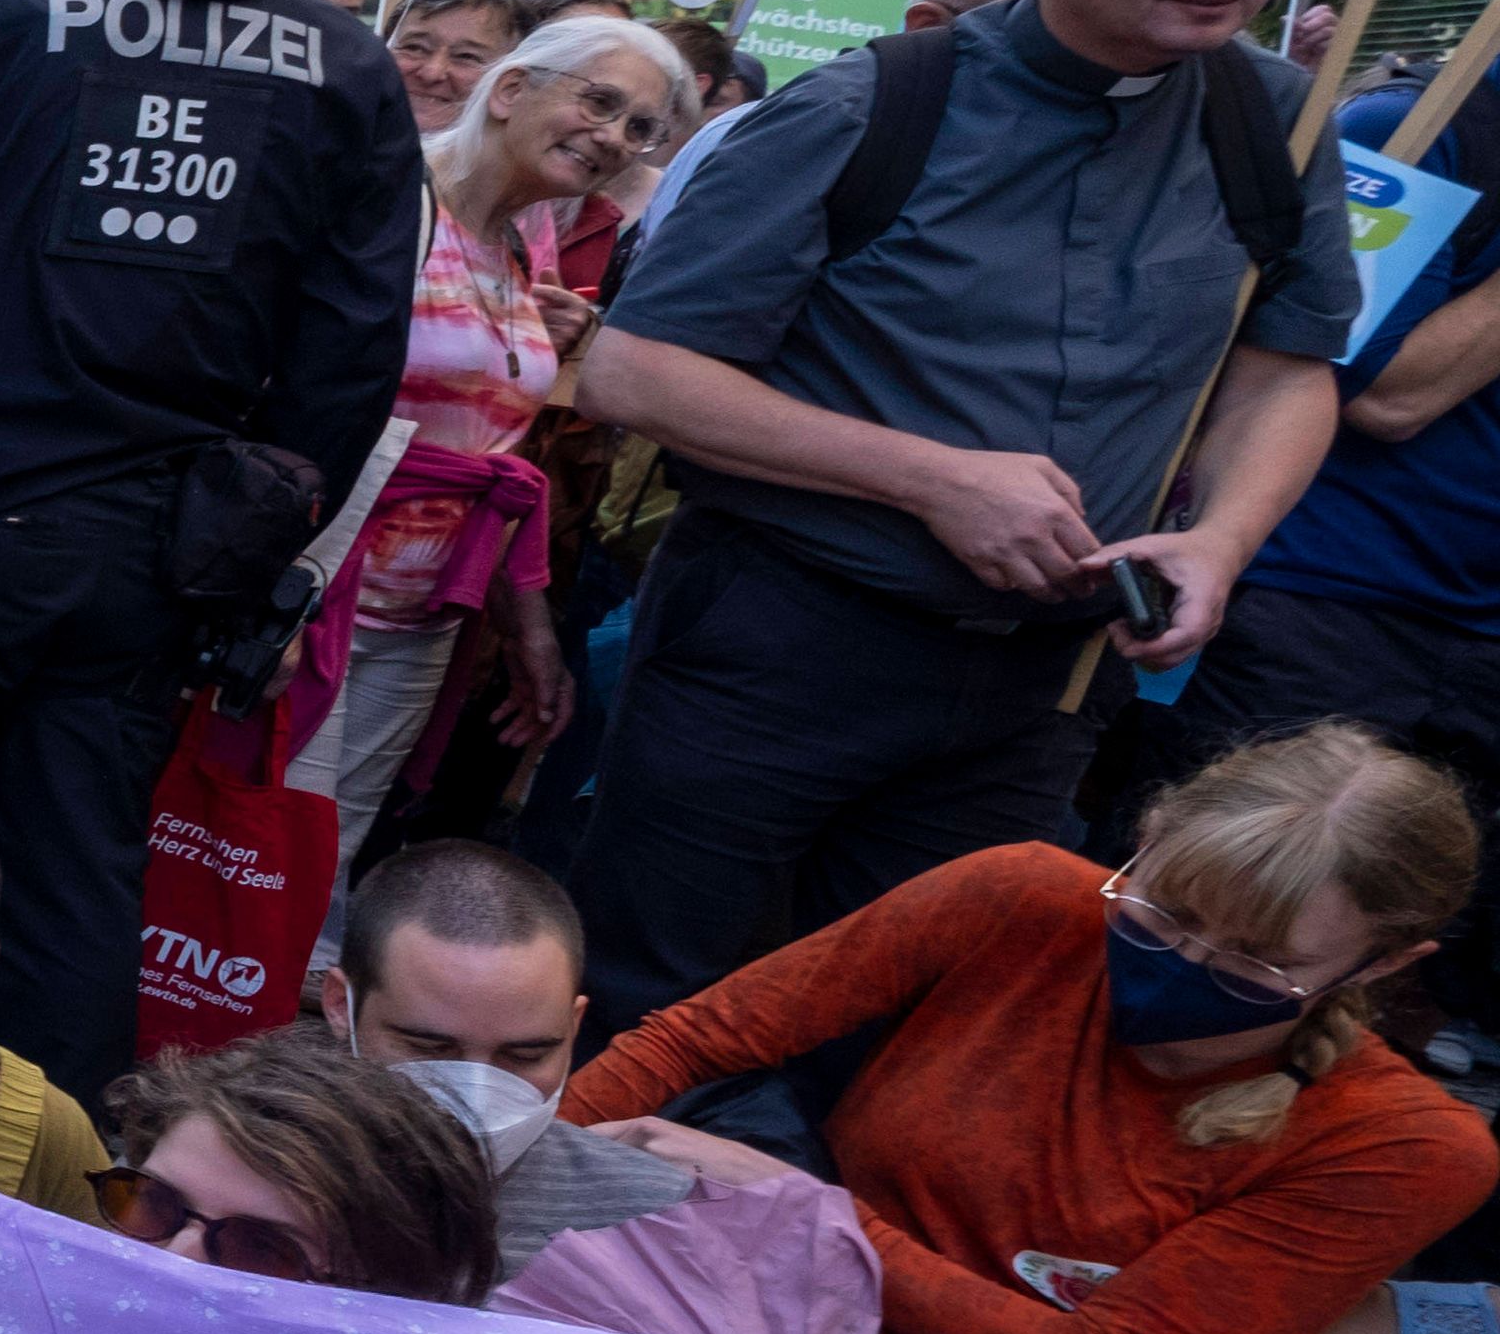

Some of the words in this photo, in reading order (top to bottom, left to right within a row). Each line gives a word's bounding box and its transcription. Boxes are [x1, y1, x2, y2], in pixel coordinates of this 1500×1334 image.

[135, 94, 208, 144] BE
[80, 143, 238, 200] 31300
[148, 833, 201, 860] Herz
[203, 852, 236, 881] und
[237, 867, 286, 891] Seele
[166, 974, 253, 1016] Fernsehen
